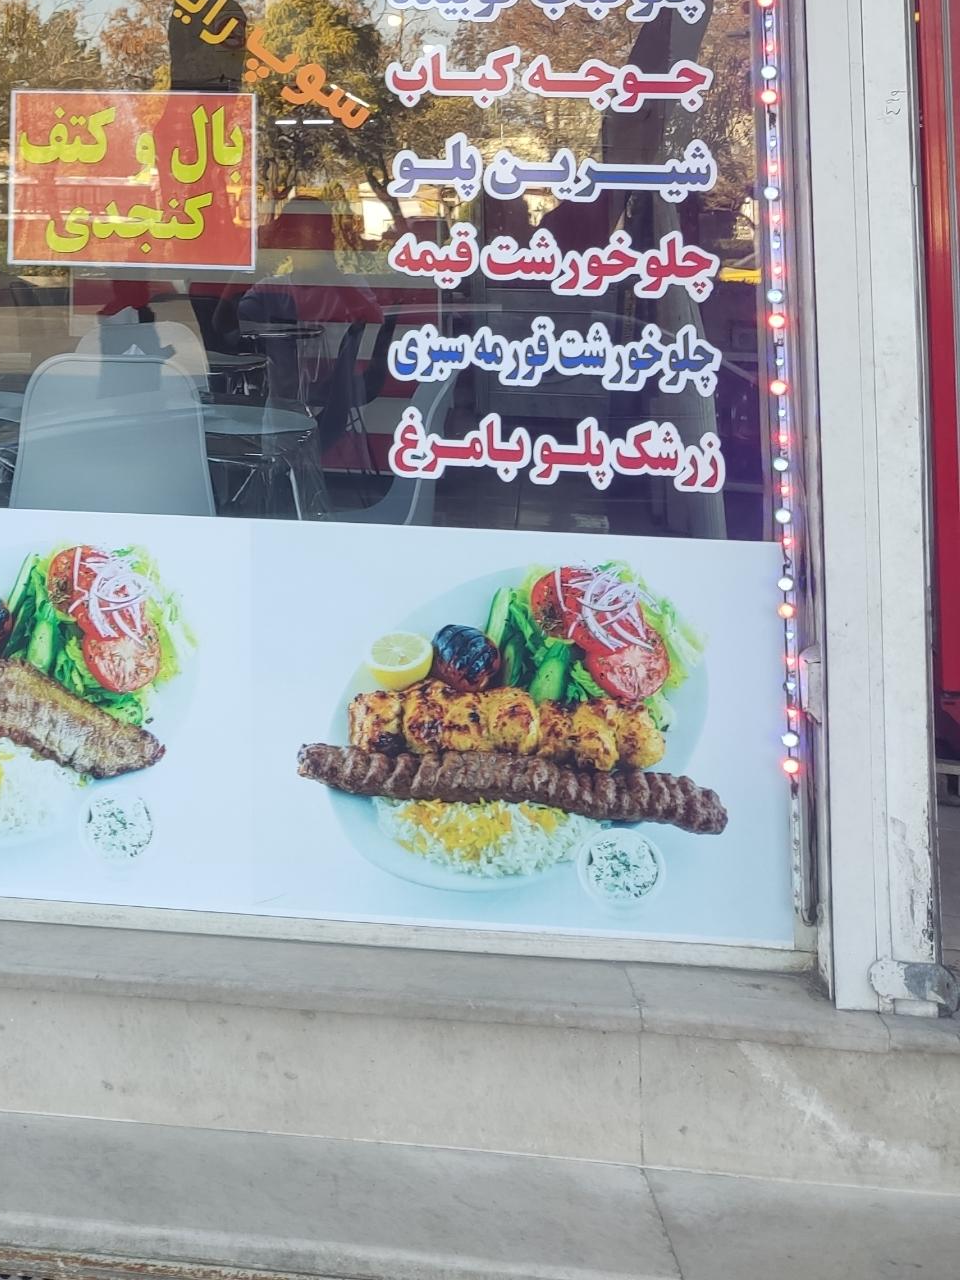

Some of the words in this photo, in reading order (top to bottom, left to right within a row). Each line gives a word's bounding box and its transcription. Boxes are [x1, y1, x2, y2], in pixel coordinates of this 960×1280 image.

[244, 28, 371, 129] سوپ
[385, 46, 520, 109] کباب
[522, 59, 714, 113] جوجه
[18, 105, 116, 164] کتف
[128, 133, 158, 183] و
[171, 105, 245, 183] بال
[387, 132, 482, 202] پلو
[484, 139, 717, 202] شیرین
[45, 192, 213, 254] کنجدی
[387, 222, 478, 289] قیمه
[388, 324, 470, 381] سبزی
[530, 417, 608, 490] پلو
[611, 421, 725, 493] زرشک
